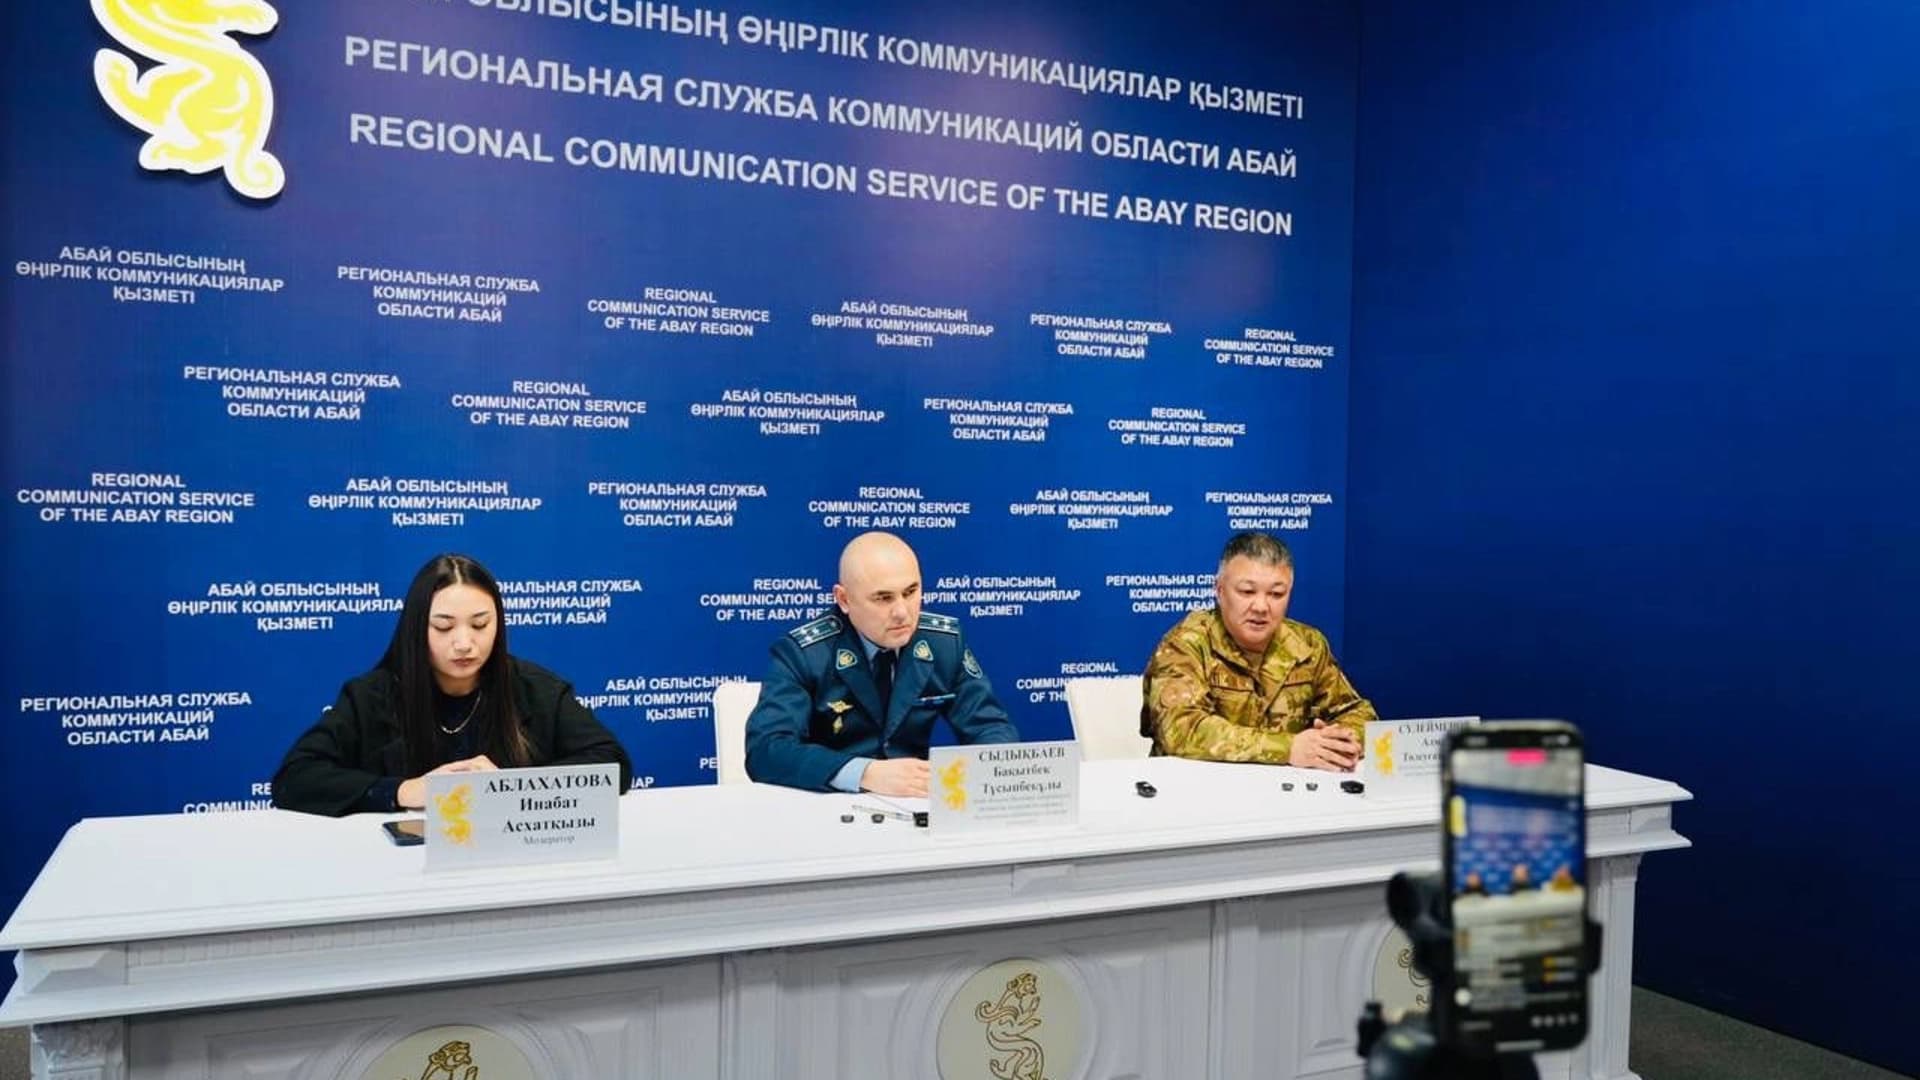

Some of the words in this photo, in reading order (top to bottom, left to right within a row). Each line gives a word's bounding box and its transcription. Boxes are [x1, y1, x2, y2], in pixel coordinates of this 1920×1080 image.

[737, 15, 870, 59] ӨҢІРЛІК
[877, 34, 1182, 102] КОММУНИКАЦИЯЛАР
[1188, 80, 1304, 120] ҚЫЗМЕТІ
[345, 35, 663, 103] РЕГИОНАЛЬНАЯ
[674, 77, 819, 121] СЛУЖБА
[828, 95, 1083, 153] КОММУНИКАЦИЙ
[1090, 130, 1220, 170] ОБЛАСТИ
[1225, 147, 1297, 179] АБАЙ
[350, 113, 555, 163] REGIONAL
[564, 136, 857, 193] COMMUNICATION
[866, 168, 998, 207] SERVICE
[1006, 183, 1046, 211] OF
[1053, 188, 1109, 219] THE
[1113, 195, 1189, 226] ABAY
[1194, 202, 1293, 237] REGION
[58, 245, 113, 263] АБАЙ
[116, 249, 247, 276] ОБЛЫСЫНЫҢ
[15, 260, 92, 280] ӨҢІРЛІК
[96, 266, 285, 293] КОММУНИКАЦИЯЛАР
[337, 265, 471, 288] РЕГИОНАЛЬНАЯ
[474, 275, 541, 293] СЛУЖБА
[112, 285, 196, 305] ҚЫЗМЕТІ
[373, 285, 507, 307] КОММУНИКАЦИЙ
[644, 287, 718, 304] REGIONAL
[377, 302, 455, 320] ОБЛАСТИ
[458, 306, 503, 323] АБАЙ
[587, 298, 709, 318] COMMUNICATION
[711, 307, 771, 323] SERVICE
[840, 300, 877, 315] АБАЙ
[879, 303, 969, 323] ОБЛЫСЫНЫҢ
[603, 315, 626, 329] OF
[627, 317, 657, 332] THE
[658, 320, 698, 334] ABAY
[700, 321, 754, 337] REGION
[810, 313, 864, 329] ӨҢІРЛІК
[865, 317, 995, 337] КОММУНИКАЦИЯЛАР
[1029, 313, 1124, 330] РЕГИОНАЛЬНАЯ
[1124, 319, 1173, 335] СЛУЖБА
[876, 333, 934, 348] ҚЫЗМЕТІ
[1054, 328, 1149, 349] КОММУНИКАЦИЙ
[1244, 327, 1297, 342] REGIONAL
[1056, 343, 1113, 357] ОБЛАСТИ
[1113, 344, 1146, 360] АБАЙ
[1203, 338, 1291, 354] COMMUNICATION
[1291, 344, 1335, 357] SERVICE
[1215, 352, 1233, 365] OF
[1232, 353, 1255, 366] THE
[1254, 355, 1283, 367] ABAY
[1283, 356, 1323, 369] REGION
[183, 364, 328, 385] РЕГИОНАЛЬНАЯ
[330, 371, 402, 389] СЛУЖБА
[222, 384, 366, 405] КОММУНИКАЦИЙ
[512, 380, 591, 397] REGIONAL
[451, 393, 581, 411] COMMUNICATION
[584, 399, 647, 414] SERVICE
[722, 388, 761, 404] АБАЙ
[763, 391, 858, 408] ОБЛЫСЫНЫҢ
[226, 401, 310, 419] ОБЛАСТИ
[313, 404, 362, 421] АБАЙ
[689, 403, 747, 419] ӨҢІРЛІК
[748, 405, 886, 426] КОММУНИКАЦИЯЛАР
[923, 397, 1023, 417] РЕГИОНАЛЬНАЯ
[1023, 401, 1075, 418] СЛУЖБА
[1150, 406, 1207, 421] REGIONAL
[469, 410, 492, 425] OF
[495, 412, 526, 427] THE
[527, 413, 570, 427] ABAY
[572, 414, 630, 430] REGION
[759, 421, 821, 436] ҚЫЗМЕТІ
[950, 412, 1050, 430] КОММУНИКАЦИЙ
[1107, 418, 1200, 433] COMMUNICATION
[1201, 422, 1247, 436] SERVICE
[954, 428, 1011, 441] ОБЛАСТИ
[1011, 428, 1046, 443] АБАЙ
[1121, 433, 1137, 445] OF
[1140, 434, 1161, 446] THE
[1161, 435, 1192, 447] ABAY
[1193, 436, 1235, 448] REGION
[91, 471, 187, 489] REGIONAL
[345, 475, 393, 492] АБАЙ
[395, 478, 509, 497] ОБЛЫСЫНЫҢ
[15, 488, 174, 505] COMMUNICATION
[179, 491, 256, 508] SERVICE
[588, 481, 707, 496] РЕГИОНАЛЬНАЯ
[708, 483, 769, 498] СЛУЖБА
[858, 485, 925, 500] REGIONAL
[1035, 488, 1069, 502] АБАЙ
[1070, 490, 1151, 504] ОБЛЫСЫНЫҢ
[307, 493, 375, 511] ӨҢІРЛІК
[378, 495, 543, 513] КОММУНИКАЦИЯЛАР
[619, 496, 738, 513] КОММУНИКАЦИЙ
[807, 499, 916, 514] COMMUNICATION
[918, 501, 971, 515] SERVICE
[1204, 491, 1290, 504] РЕГИОНАЛЬНАЯ
[1290, 492, 1333, 507] СЛУЖБА
[39, 506, 67, 522] OF
[70, 507, 108, 523] THE
[110, 508, 162, 523] ABAY
[164, 508, 235, 524] REGION
[1008, 503, 1057, 517] ӨҢІРЛІК
[1057, 502, 1174, 518] КОММУНИКАЦИЯЛАР
[1226, 504, 1312, 517] КОММУНИКАЦИЙ
[391, 512, 465, 529] ҚЫЗМЕТІ
[623, 513, 692, 527] ОБЛАСТИ
[694, 512, 735, 527] АБАЙ
[822, 515, 842, 528] OF
[844, 515, 869, 527] THE
[873, 516, 906, 527] ABAY
[908, 516, 957, 529] REGION
[1067, 517, 1119, 531] ҚЫЗМЕТІ
[1229, 517, 1279, 530] ОБЛАСТИ
[1280, 517, 1309, 530] АБАЙ
[206, 580, 257, 598] АБАЙ
[259, 581, 381, 598] ОБЛЫСЫНЫҢ
[580, 578, 644, 593] СЛУЖБА
[752, 577, 822, 591] REGIONAL
[935, 574, 971, 589] АБАЙ
[972, 575, 1057, 590] ОБЛЫСЫНЫҢ
[1105, 574, 1196, 587] РЕГИОНАЛЬНАЯ
[699, 593, 819, 607] COMMUNICATION
[959, 589, 1082, 604] КОММУНИКАЦИЯЛАР
[167, 599, 239, 617] ӨҢІРЛІК
[241, 598, 405, 615] КОММУНИКАЦИЯЛА
[715, 608, 736, 622] OF
[737, 608, 766, 621] THE
[767, 608, 803, 621] ABAY
[969, 604, 1024, 619] ҚЫЗМЕТІ
[1131, 601, 1183, 614] ОБЛАСТИ
[256, 615, 334, 633] ҚЫЗМЕТІ
[565, 608, 608, 625] АБАЙ
[1060, 661, 1119, 674] REGIONAL
[604, 675, 647, 692] АБАЙ
[20, 693, 174, 713] РЕГИОНАЛЬНАЯ
[177, 691, 253, 707] СЛУЖБА
[633, 691, 714, 707] КОММУНИК
[1029, 691, 1046, 703] OF
[61, 706, 215, 729] КОММУНИКАЦИЙ
[645, 707, 708, 723] ҚЫЗМЕТІ
[66, 729, 156, 746] ОБЛАСТИ
[158, 724, 210, 743] АБАЙ
[485, 774, 613, 794] АБЛАХАТОВА
[520, 796, 578, 812] Инабат
